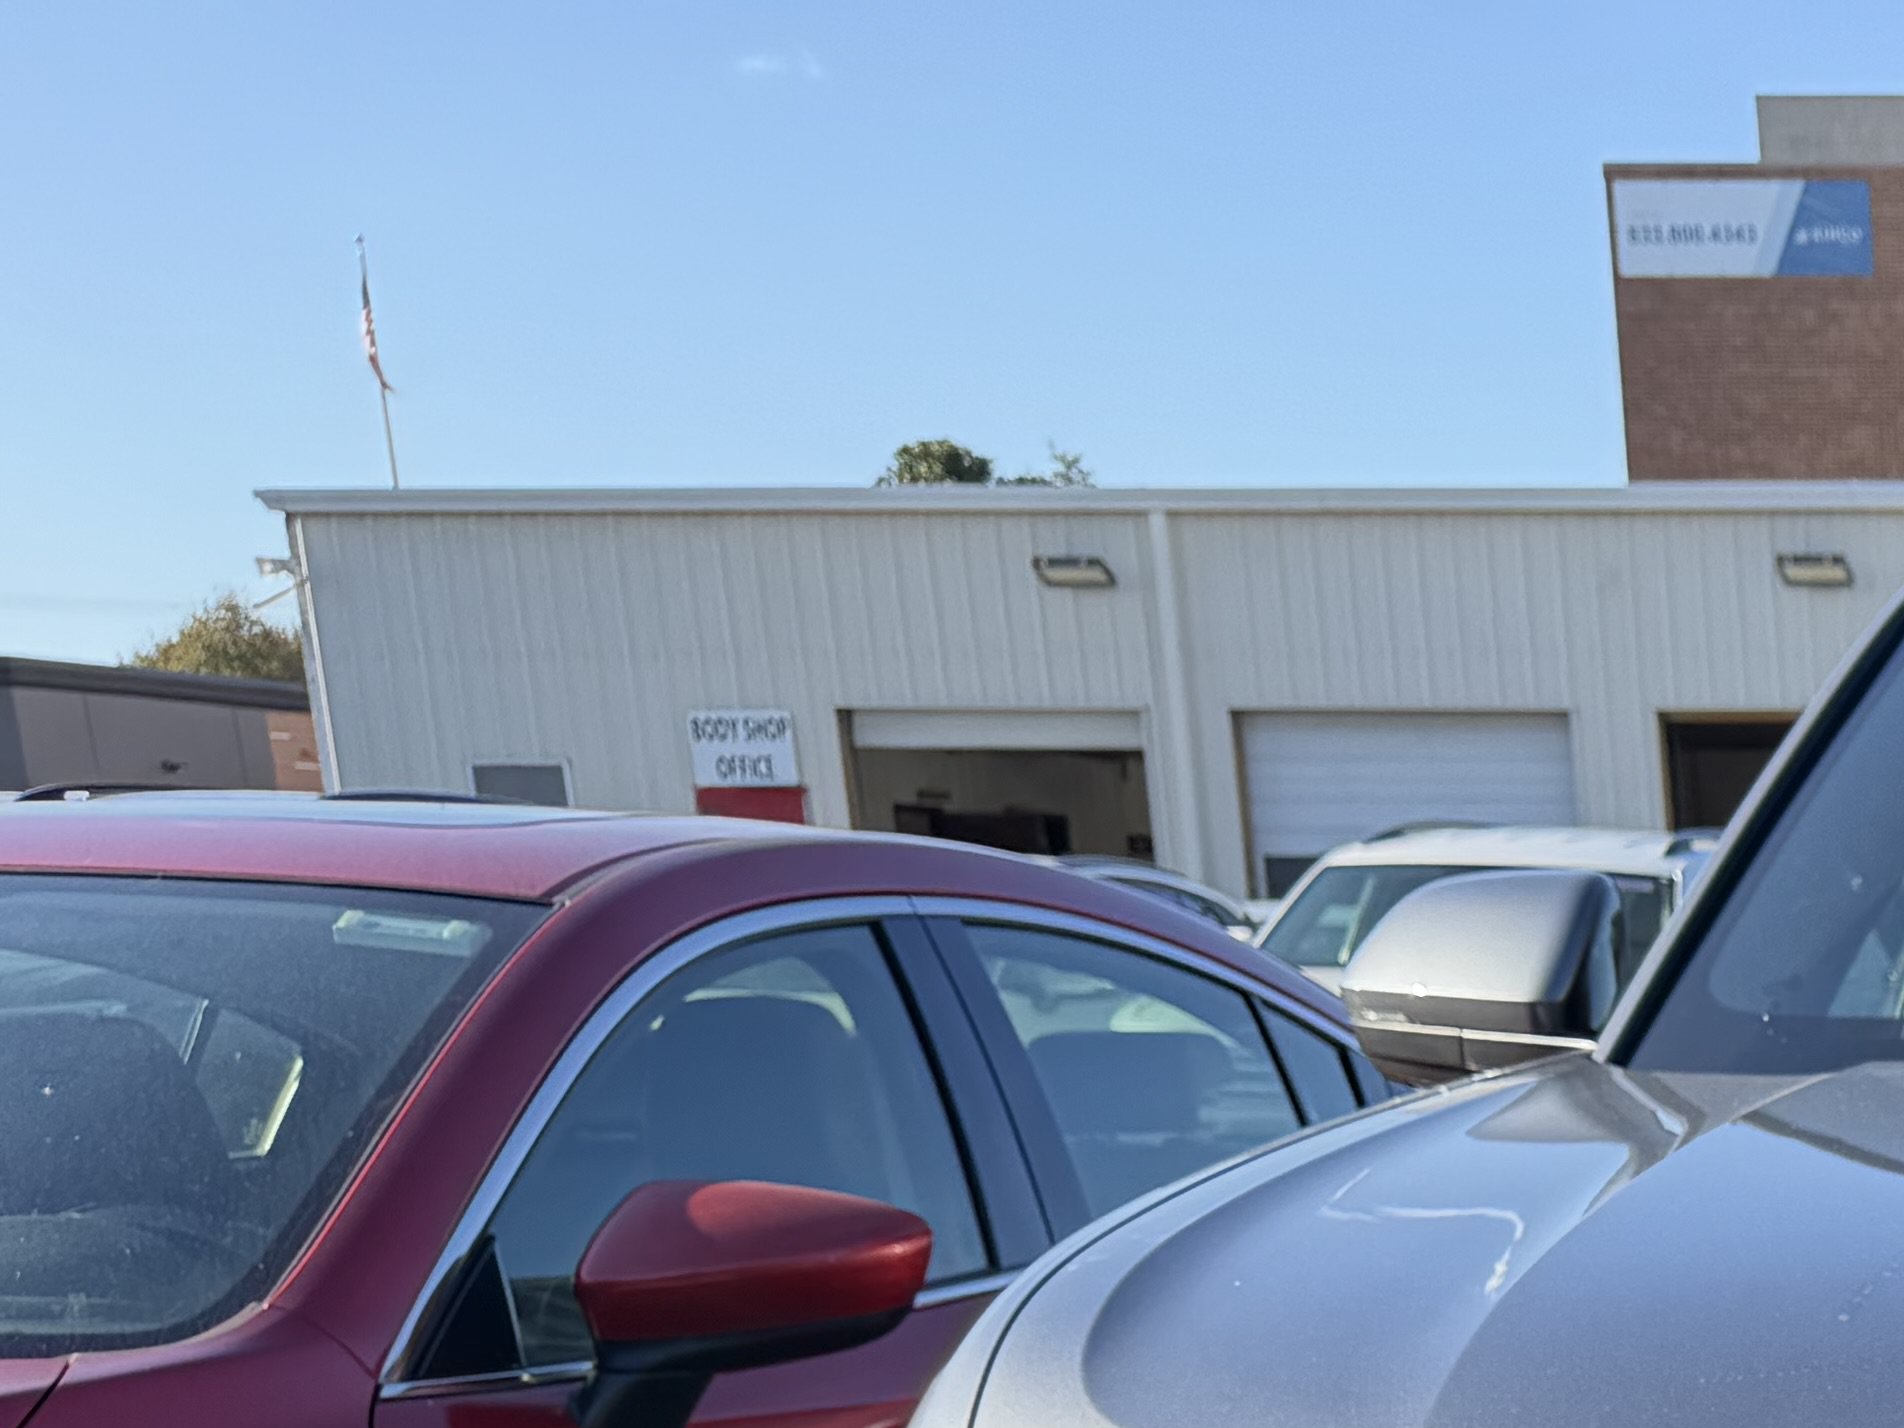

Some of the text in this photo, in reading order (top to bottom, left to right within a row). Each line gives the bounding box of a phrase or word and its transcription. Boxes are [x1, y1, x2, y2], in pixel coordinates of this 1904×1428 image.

[690, 714, 787, 744] BODY SHOP
[715, 754, 774, 781] OFFICE
